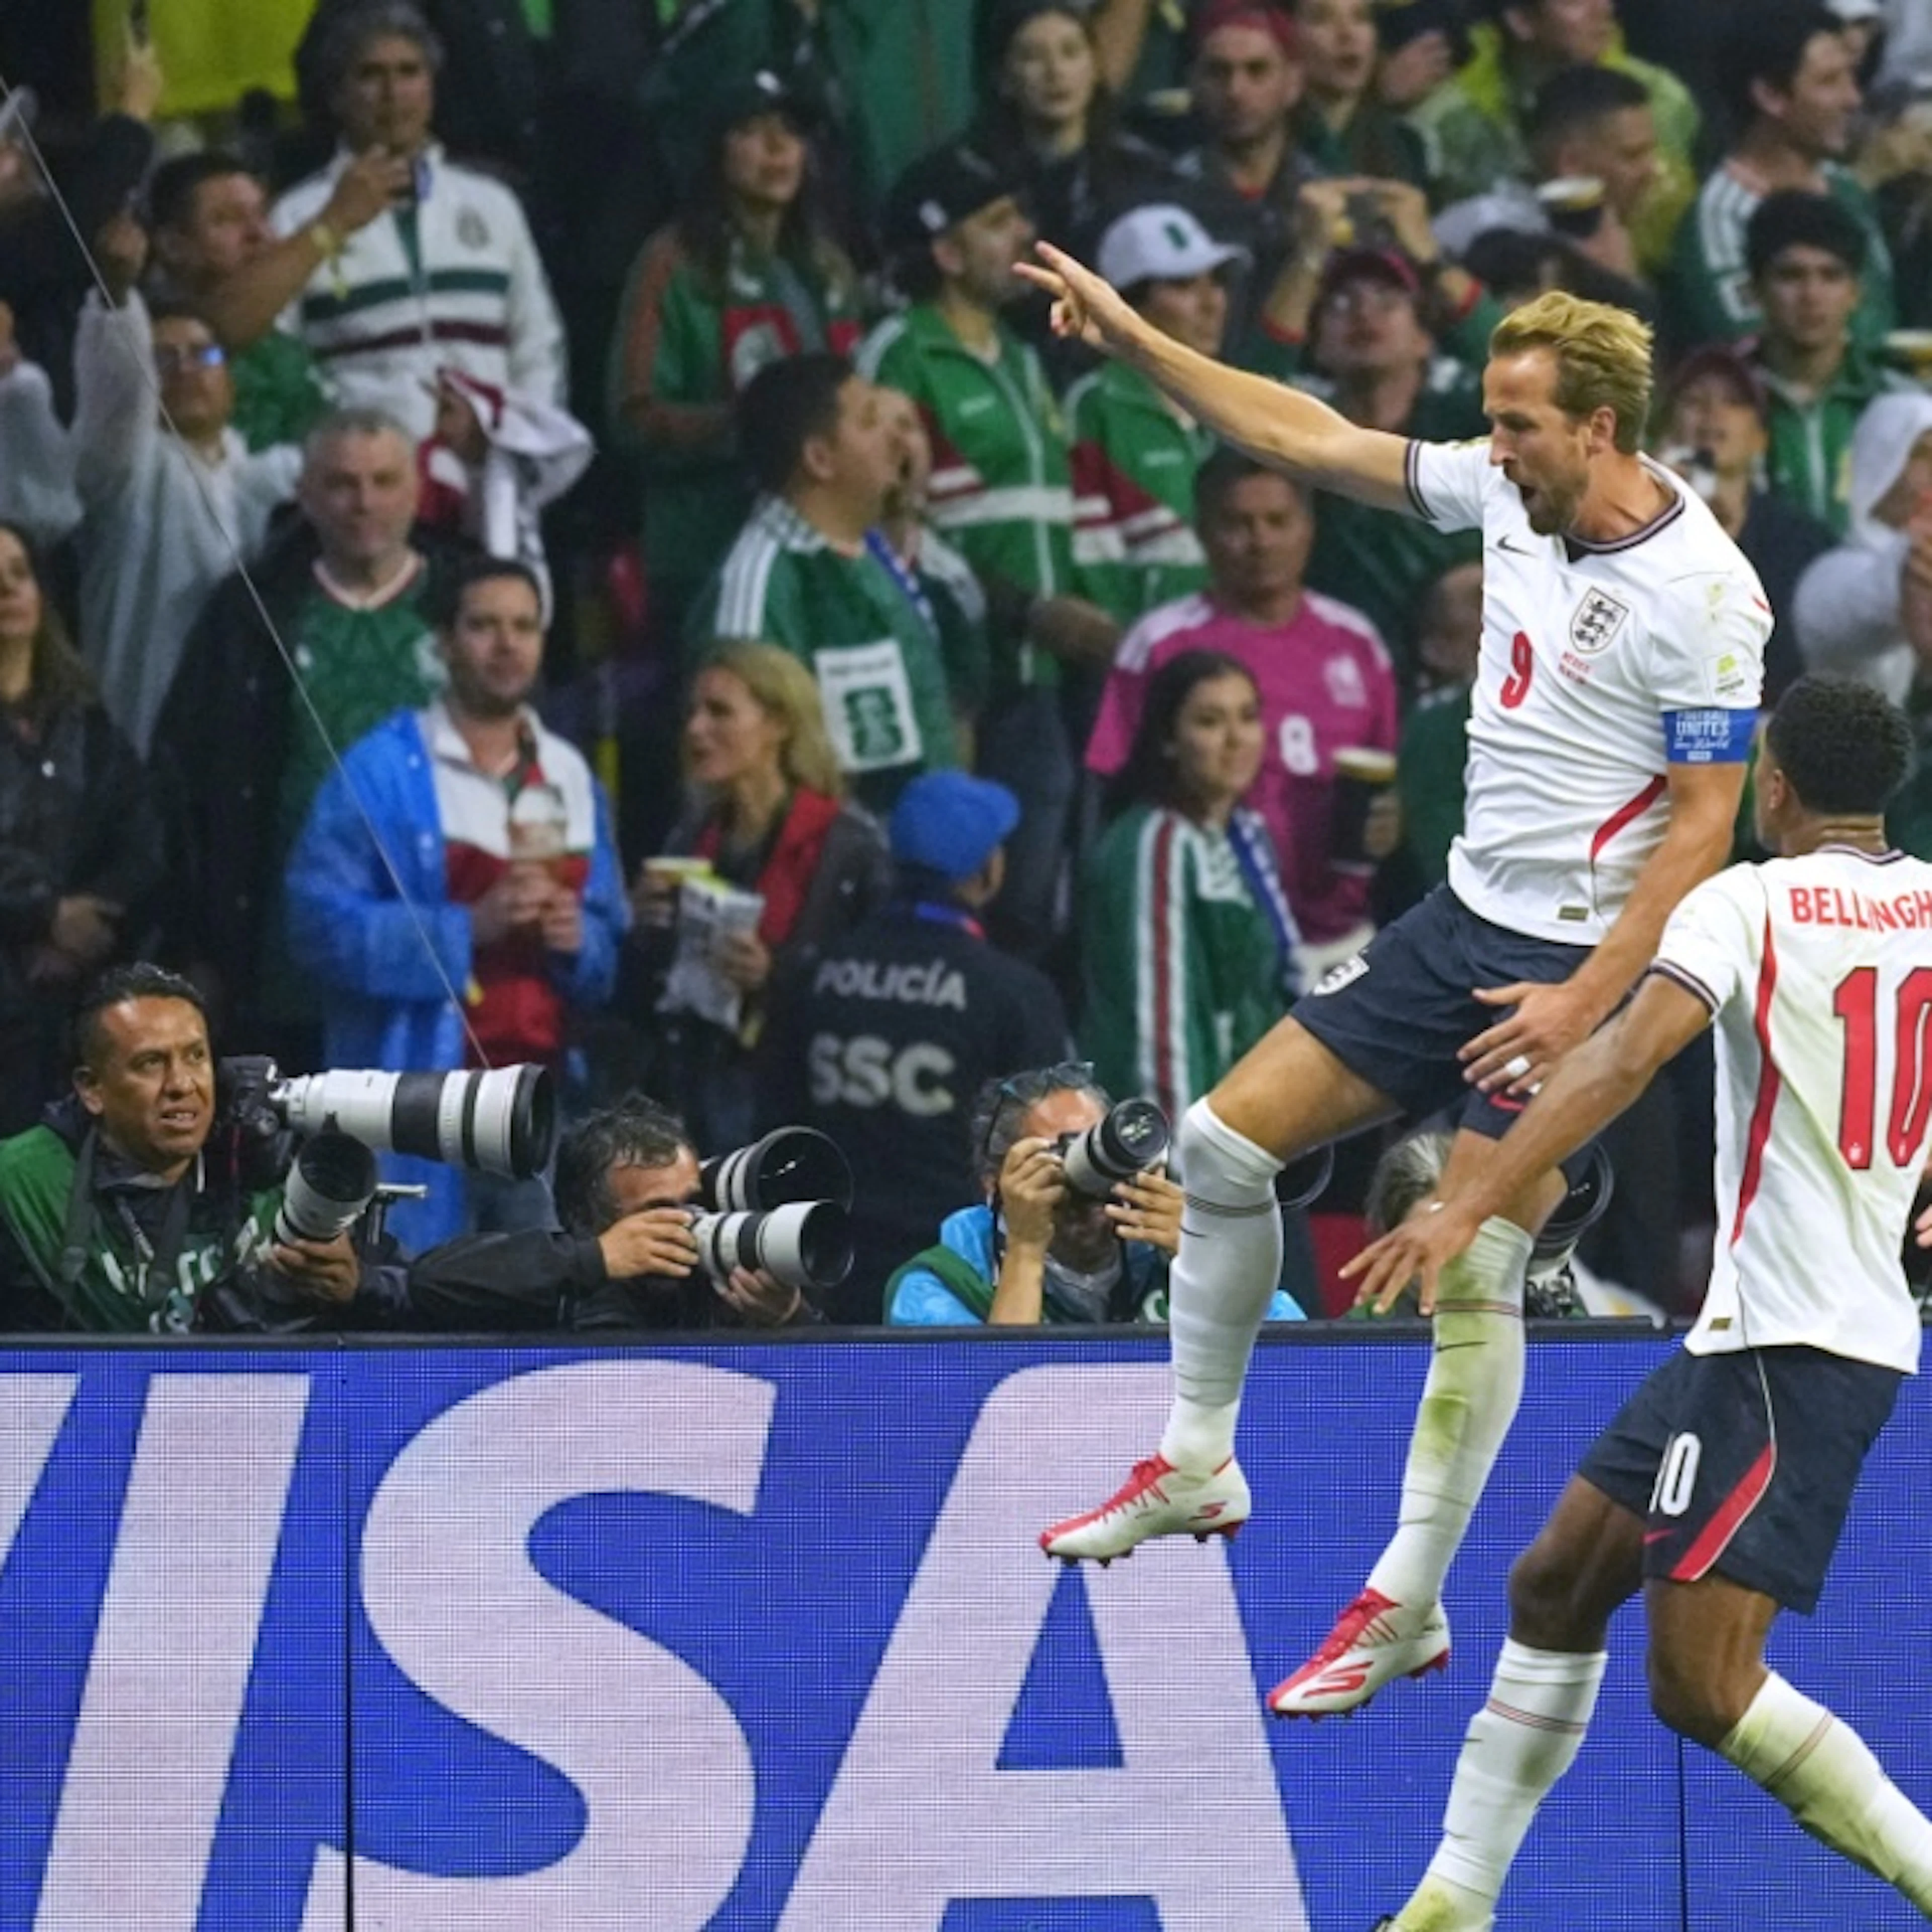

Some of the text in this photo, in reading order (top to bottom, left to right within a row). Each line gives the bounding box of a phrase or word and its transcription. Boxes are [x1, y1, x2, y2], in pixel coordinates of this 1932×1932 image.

[1500, 631, 1533, 708] 9
[1675, 721, 1730, 737] UNITES
[813, 958, 967, 1010] POLICÍA
[810, 1033, 956, 1116] SSC
[1833, 967, 1932, 1169] 10
